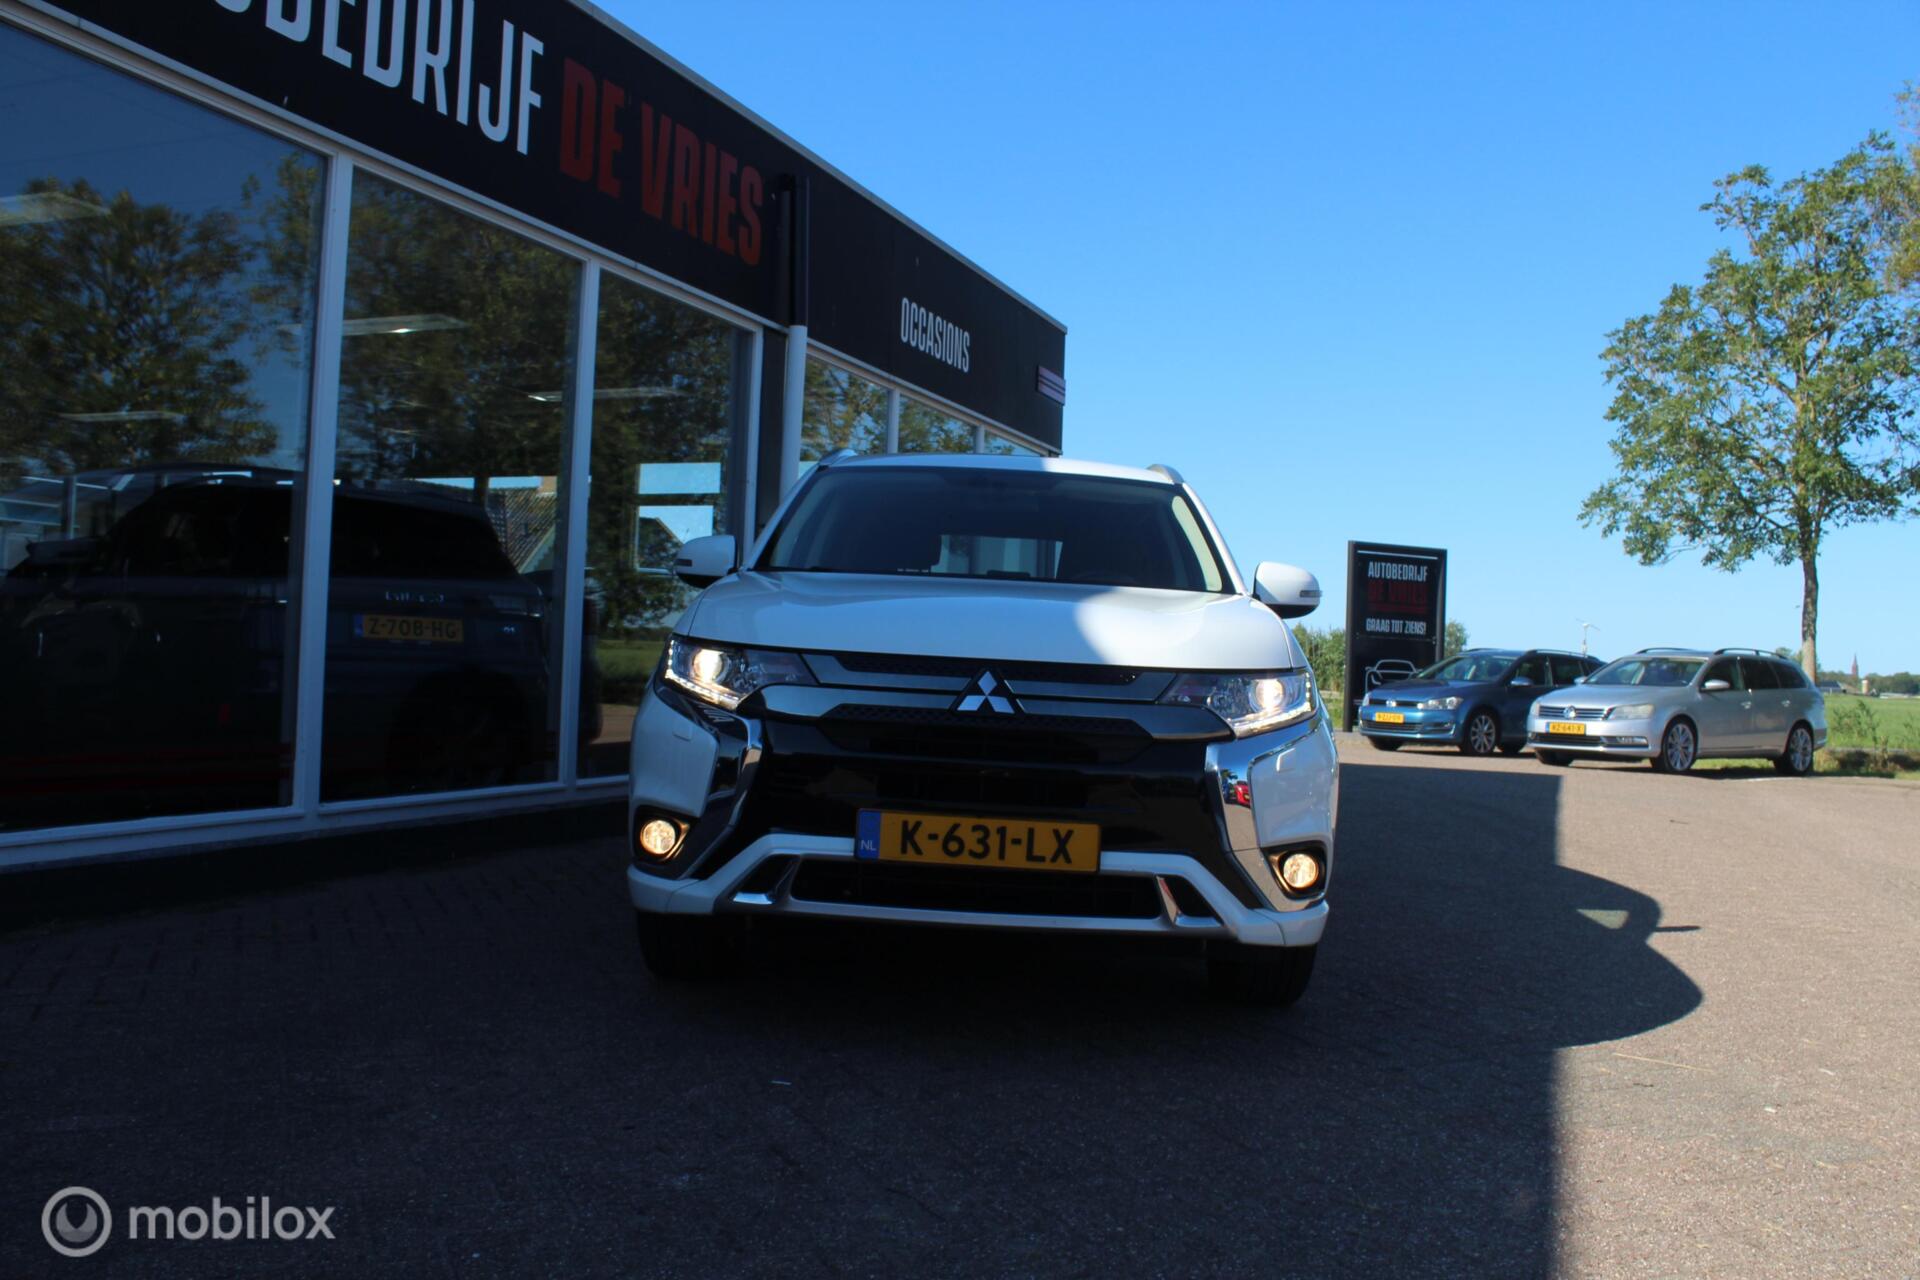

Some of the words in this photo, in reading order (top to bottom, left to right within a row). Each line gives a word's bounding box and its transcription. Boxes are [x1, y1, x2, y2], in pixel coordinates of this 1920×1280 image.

[214, 0, 545, 156] DRIJF
[560, 57, 625, 199] DE
[641, 101, 764, 267] VRIES
[900, 297, 971, 374] OCCASIONS
[1367, 561, 1428, 582] AUTOBEDRIJF
[1366, 618, 1390, 633] GRAAG
[1391, 619, 1403, 634] TOT
[1404, 620, 1427, 635] ZIENS!
[860, 839, 877, 851] NL
[900, 820, 1074, 864] K-631-LX
